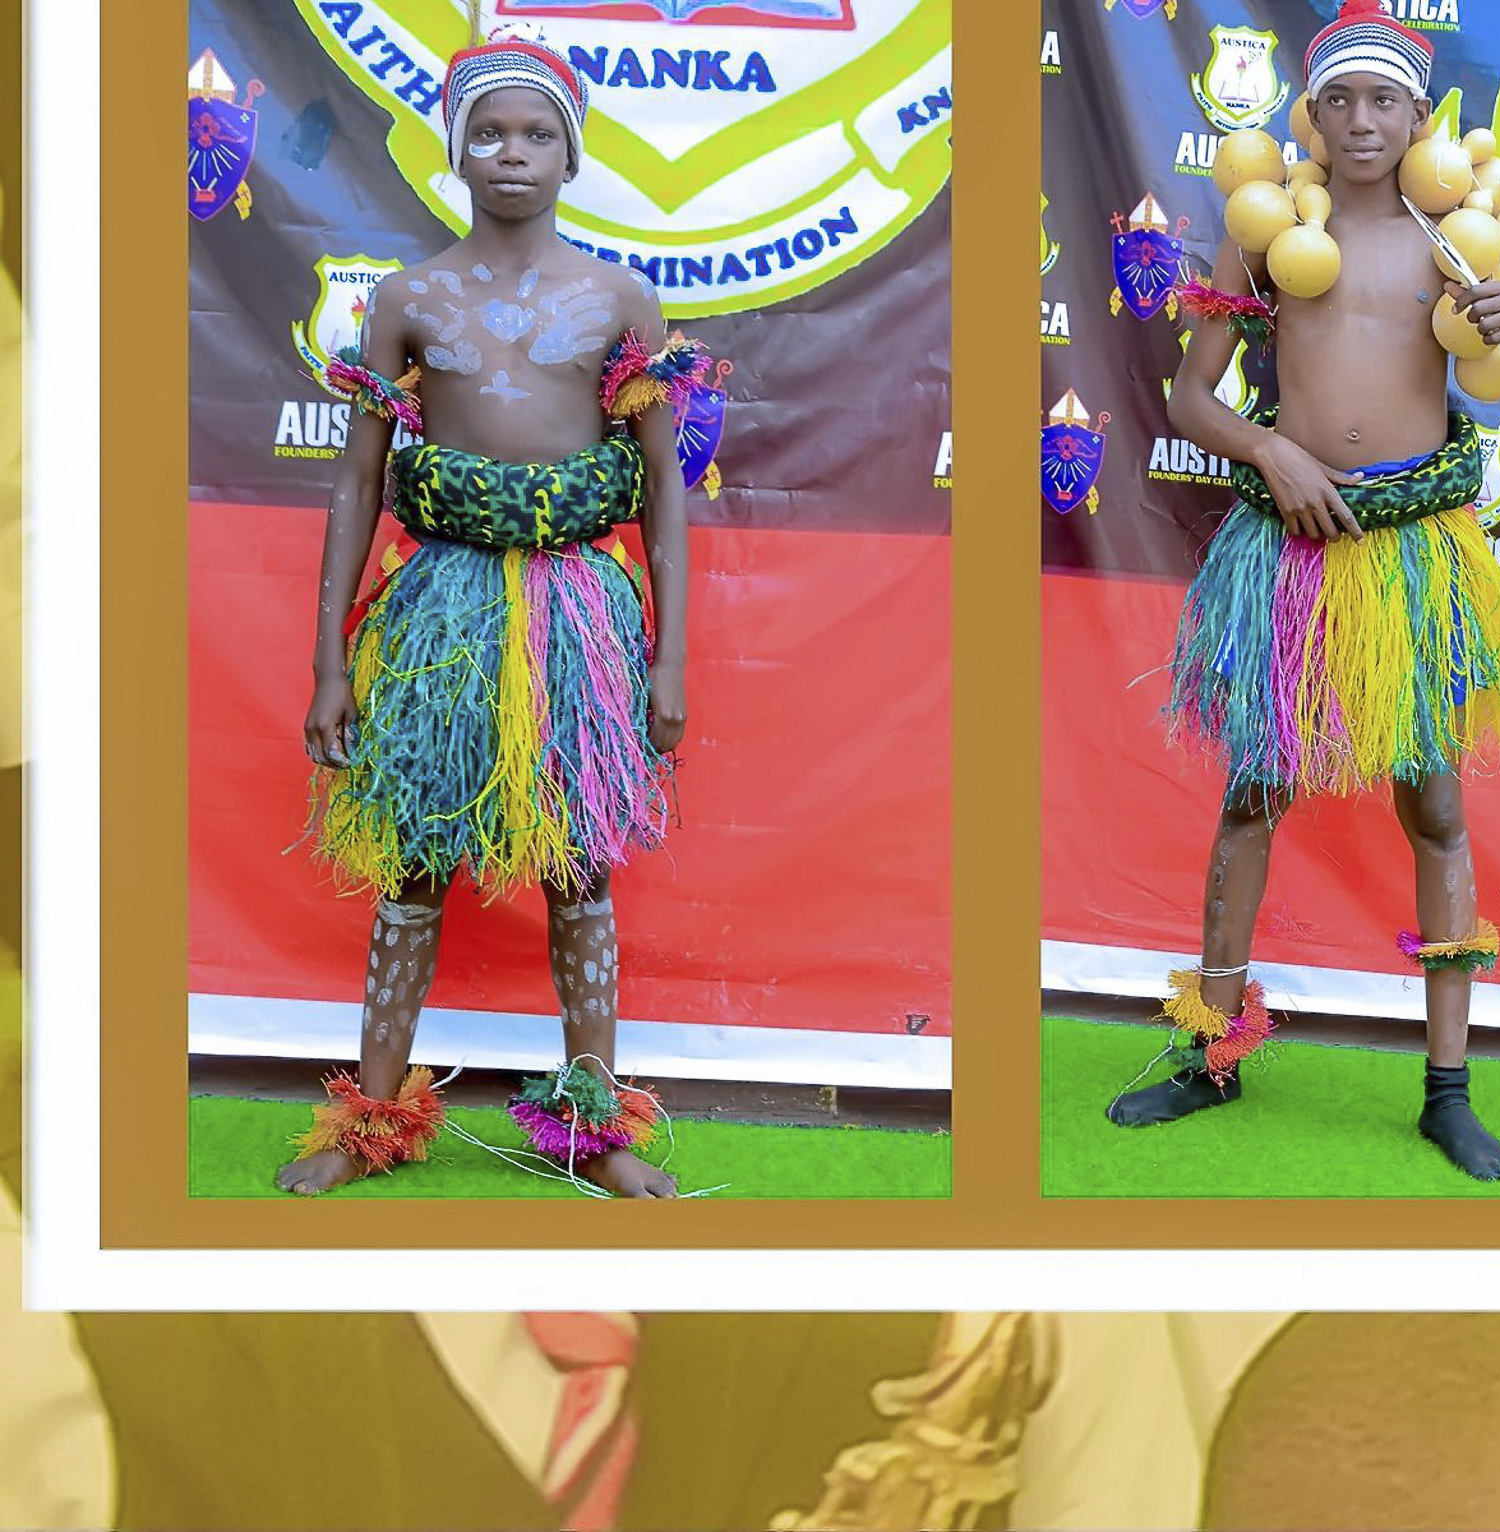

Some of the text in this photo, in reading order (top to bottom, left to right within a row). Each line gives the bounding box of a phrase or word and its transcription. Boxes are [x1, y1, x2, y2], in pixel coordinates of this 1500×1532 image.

[1220, 37, 1266, 50] AUSTICA
[568, 45, 776, 92] NANKA
[1148, 470, 1195, 482] FOUNDERS'
[1196, 475, 1212, 485] DAY
